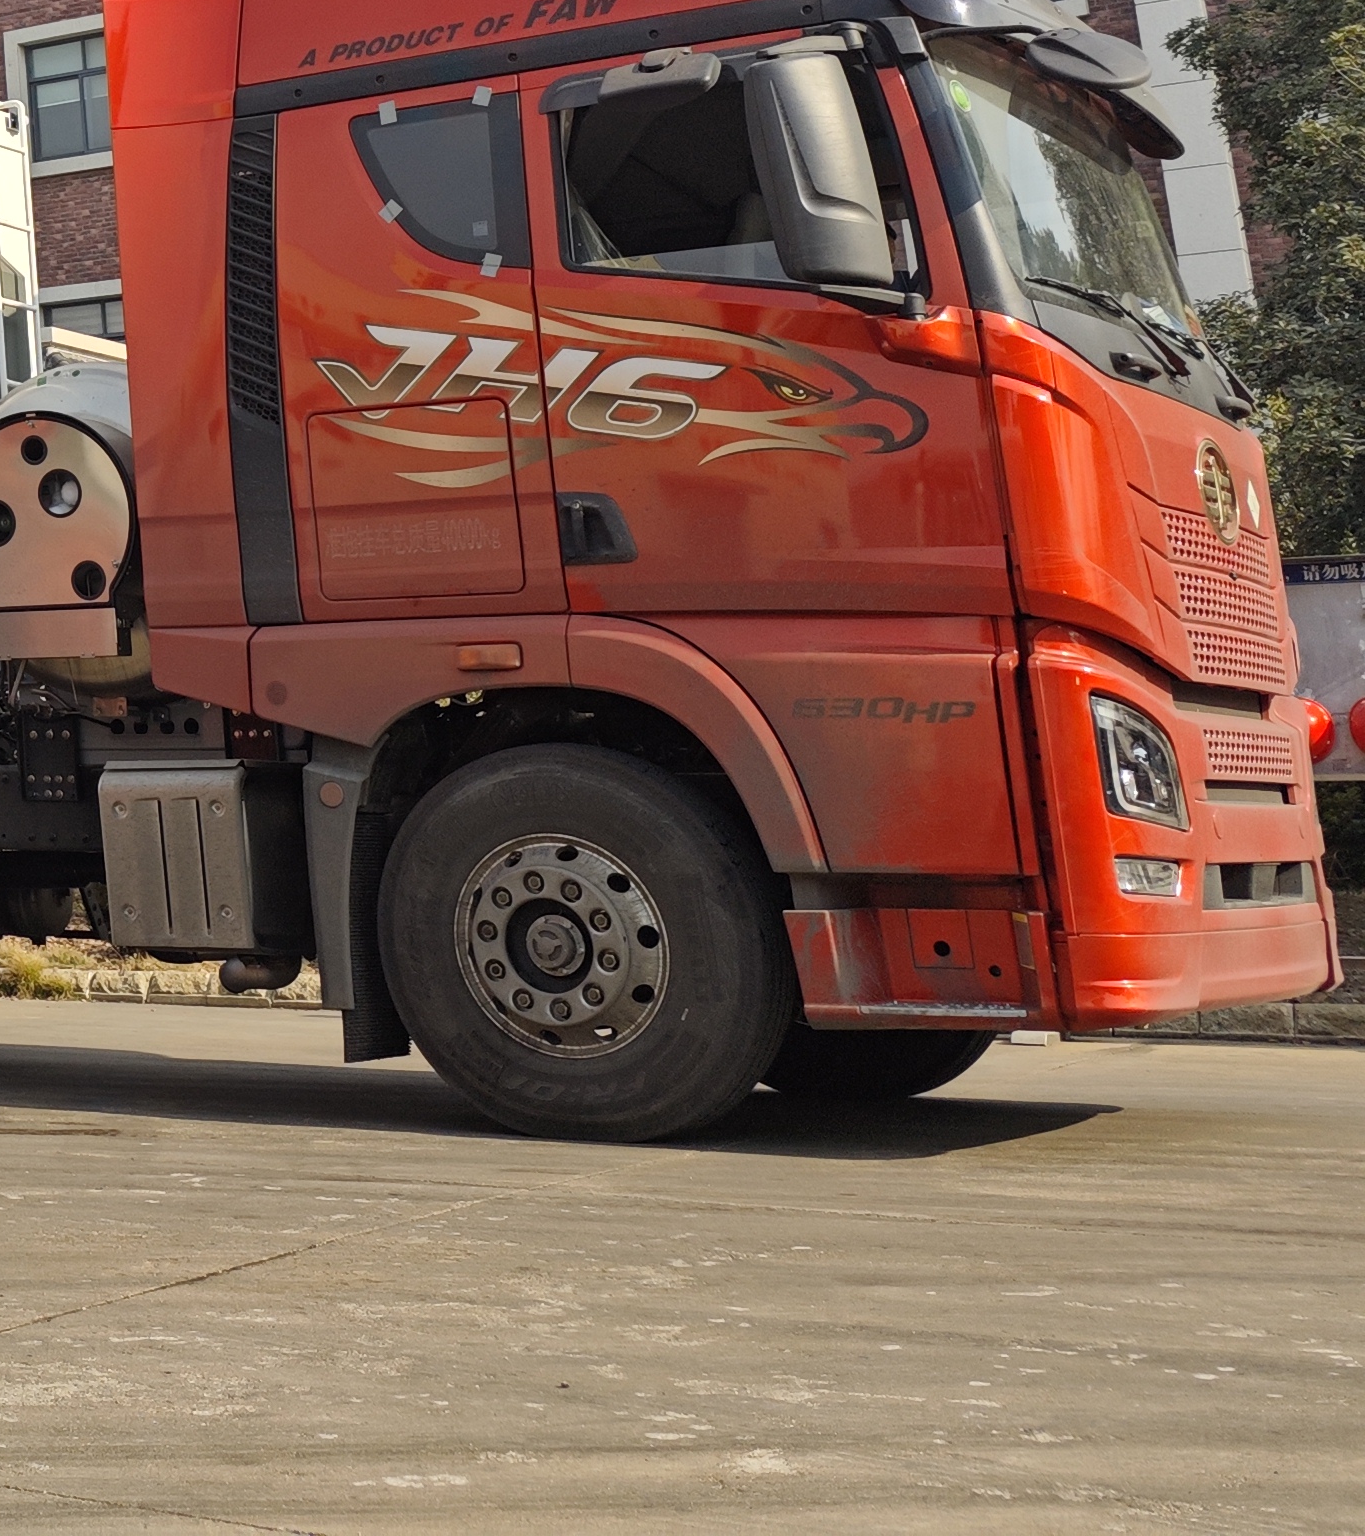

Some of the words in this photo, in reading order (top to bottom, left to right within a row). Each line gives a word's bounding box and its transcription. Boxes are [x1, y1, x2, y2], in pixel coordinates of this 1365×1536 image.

[298, 49, 316, 69] A
[328, 22, 464, 63] PRODUCT
[473, 14, 514, 38] OF
[313, 324, 730, 440] JH6
[792, 696, 976, 724] 630HP
